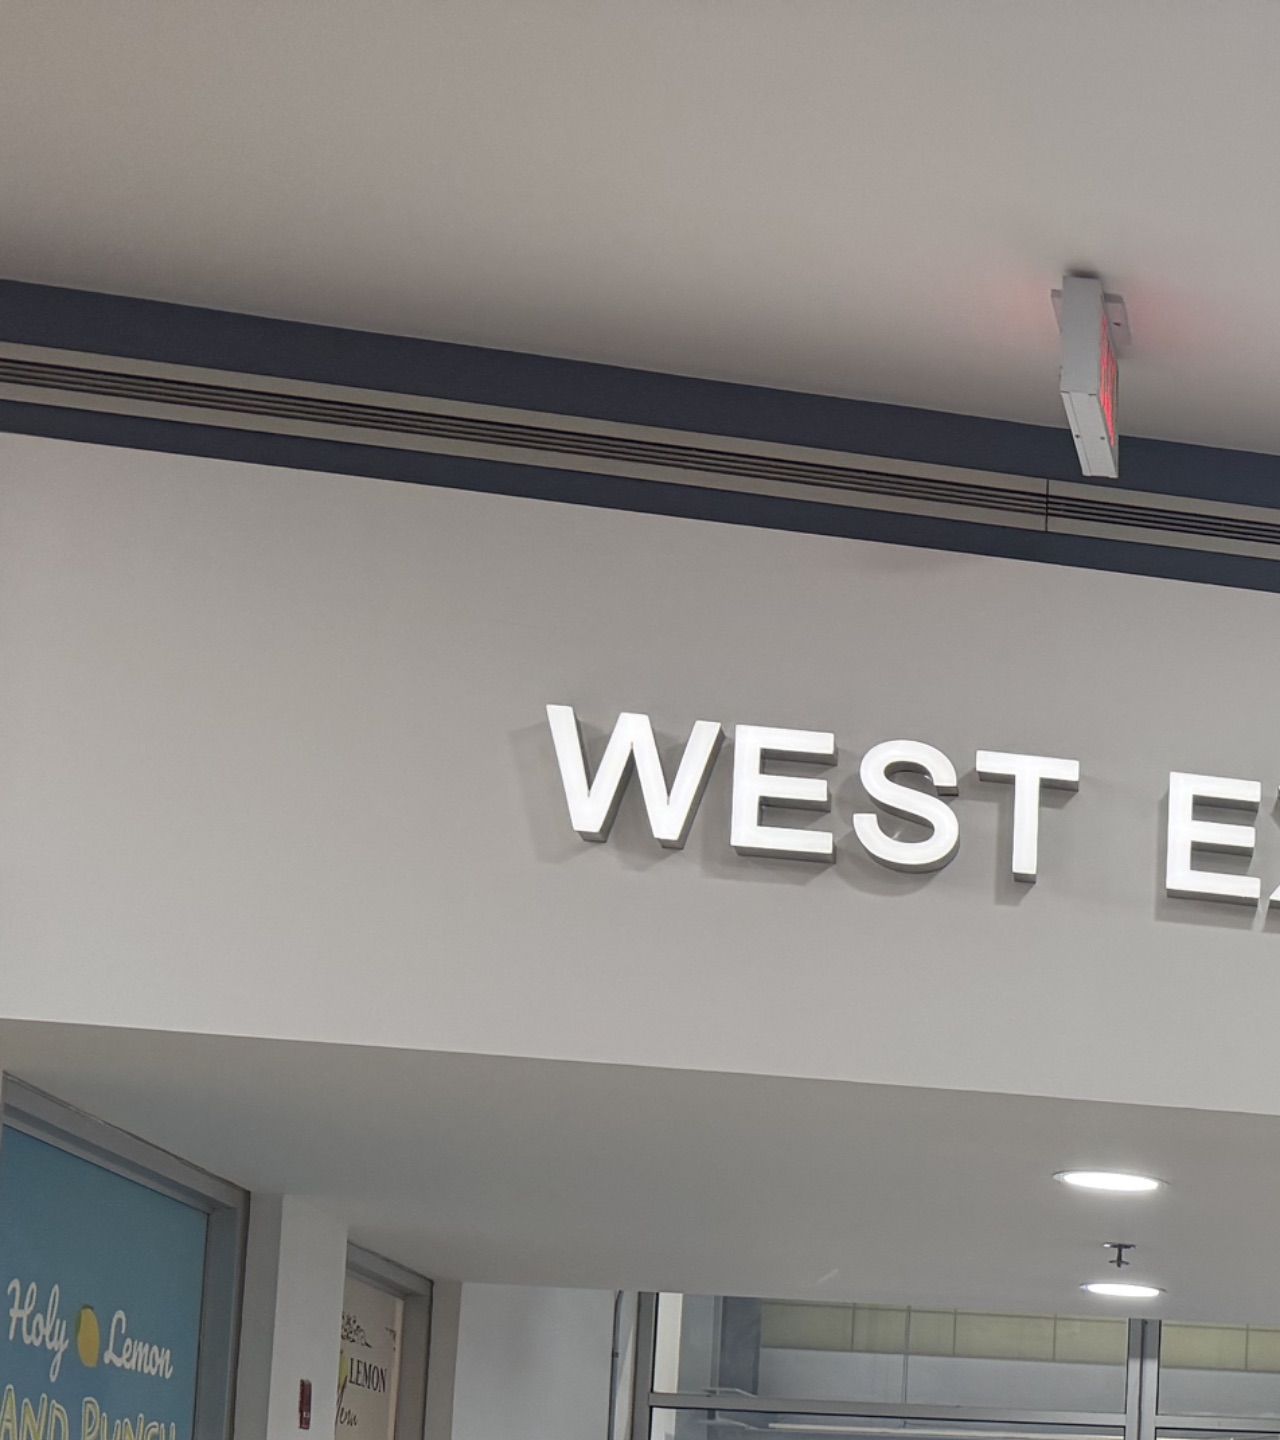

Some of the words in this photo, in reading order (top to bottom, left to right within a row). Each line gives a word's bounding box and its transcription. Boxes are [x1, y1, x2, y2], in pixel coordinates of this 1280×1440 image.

[545, 704, 1080, 883] WEST
[7, 1277, 69, 1383] Holy
[103, 1309, 174, 1380] Lemon
[348, 1357, 388, 1394] LEMON
